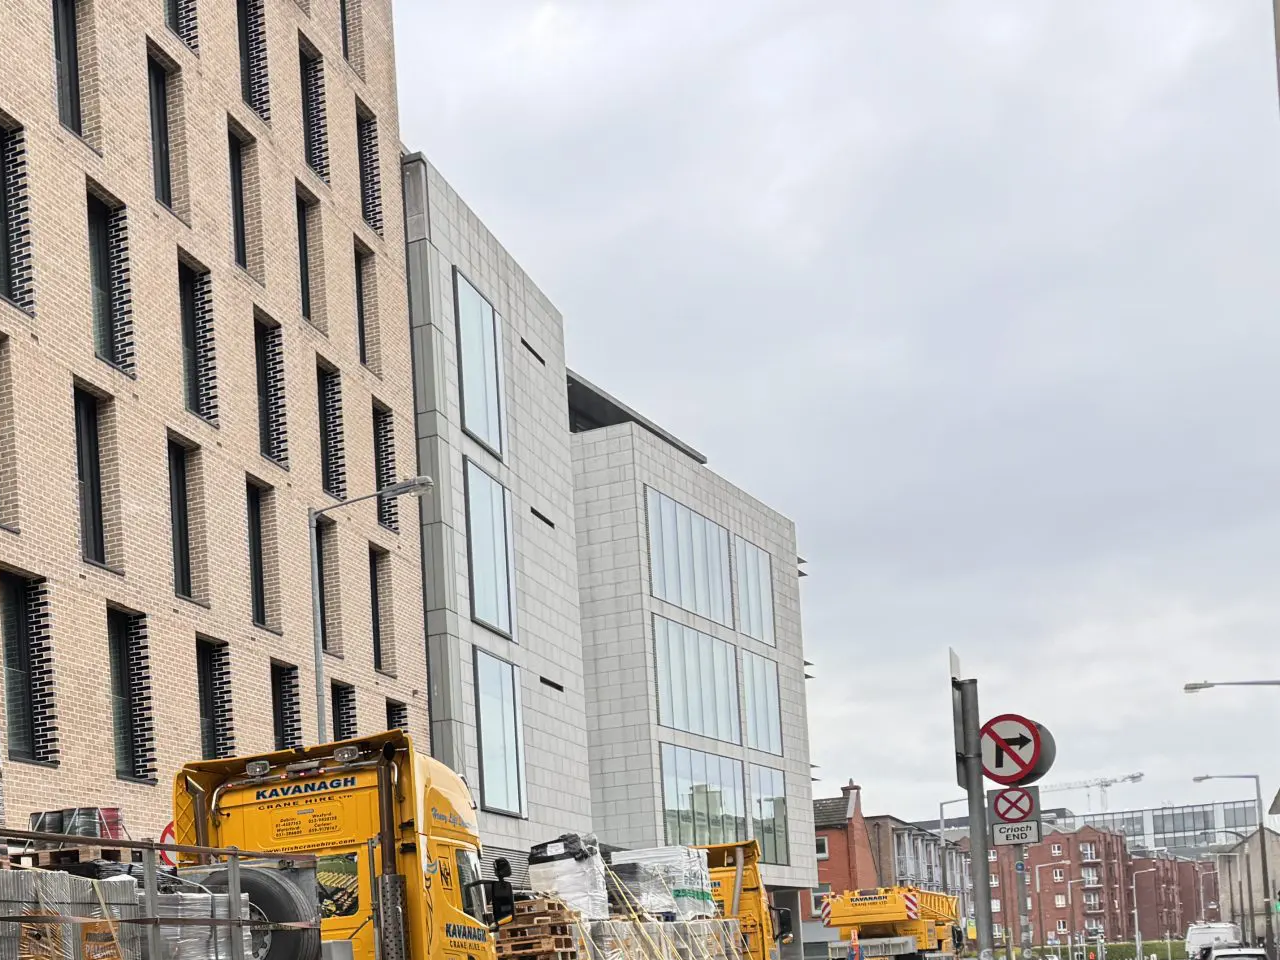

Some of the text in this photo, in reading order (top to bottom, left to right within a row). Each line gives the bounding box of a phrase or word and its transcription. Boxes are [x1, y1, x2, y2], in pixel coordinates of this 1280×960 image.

[256, 777, 356, 800] KAVANAGH
[258, 801, 299, 811] CRANE
[305, 796, 335, 806] HIRE
[999, 825, 1032, 834] Crioch
[1006, 833, 1028, 841] END
[446, 923, 487, 943] KAVANAGH
[449, 940, 467, 950] CRANE
